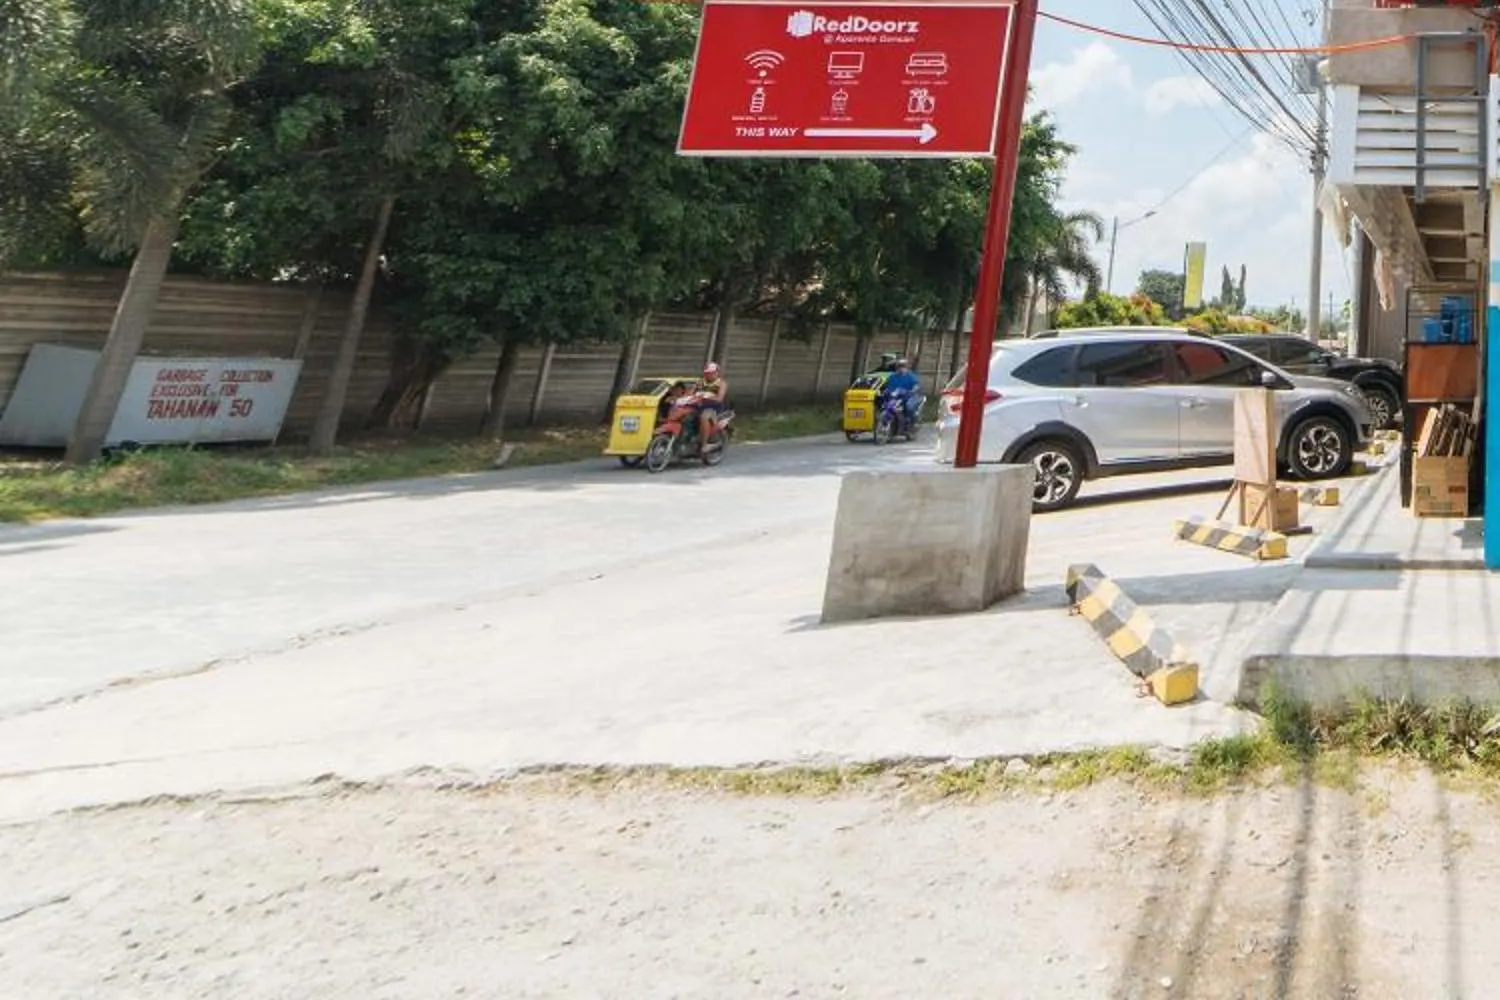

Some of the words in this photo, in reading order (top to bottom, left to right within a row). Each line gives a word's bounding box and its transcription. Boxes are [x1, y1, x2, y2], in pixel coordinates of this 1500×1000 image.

[813, 15, 919, 33] RedDoorz
[735, 126, 765, 137] THIS
[768, 126, 799, 137] WAY
[220, 383, 240, 396] FOR
[147, 399, 220, 419] TAHANAN
[229, 398, 253, 417] 50
